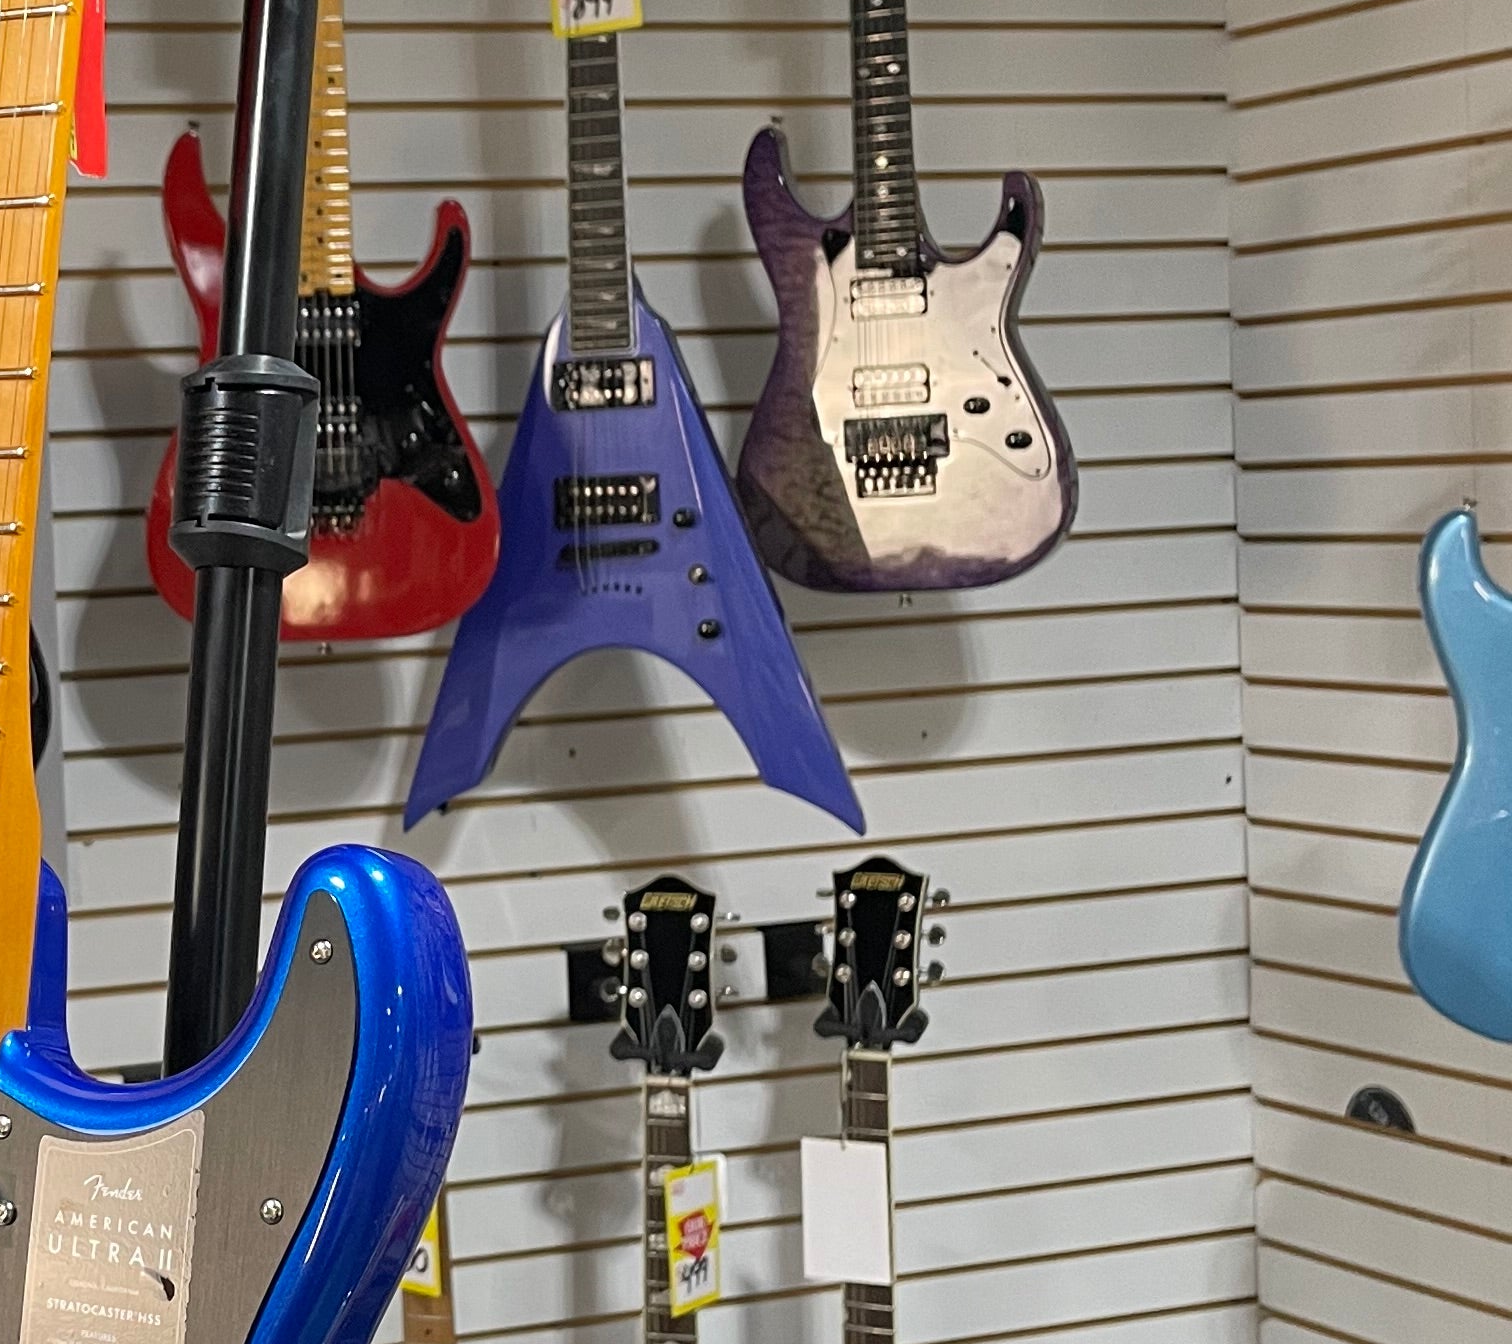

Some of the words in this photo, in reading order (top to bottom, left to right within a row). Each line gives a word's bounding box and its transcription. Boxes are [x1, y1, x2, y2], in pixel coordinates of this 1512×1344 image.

[83, 1174, 143, 1201] Fender
[54, 1209, 173, 1240] AMERICAN
[48, 1233, 145, 1268] ULTRA
[159, 1248, 172, 1271] II
[137, 1312, 161, 1326] HSS
